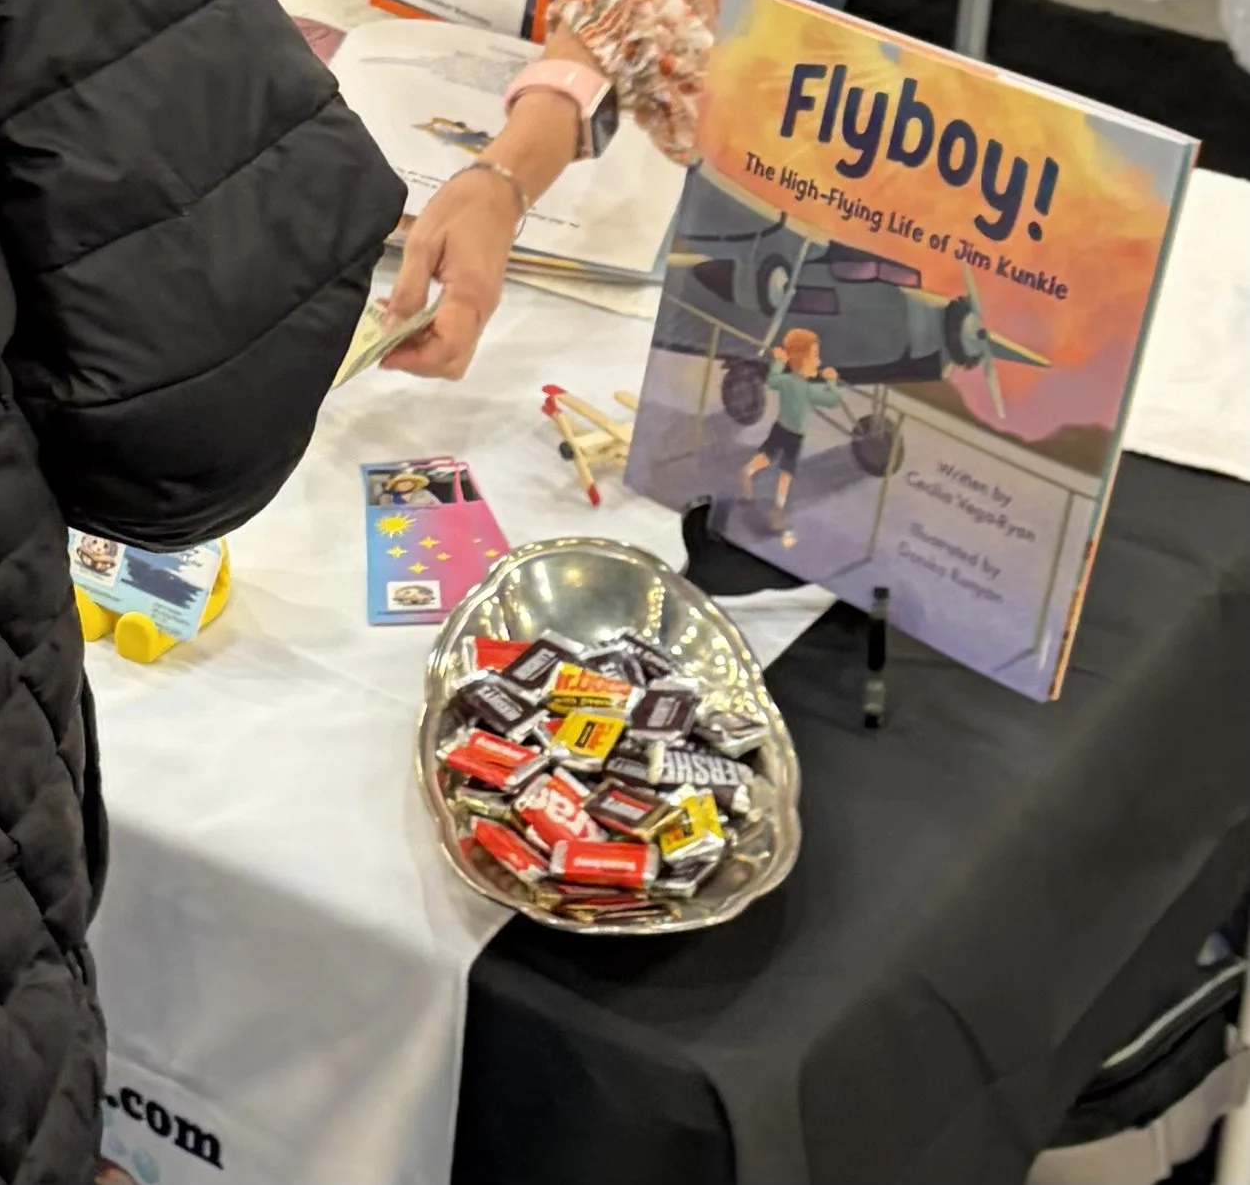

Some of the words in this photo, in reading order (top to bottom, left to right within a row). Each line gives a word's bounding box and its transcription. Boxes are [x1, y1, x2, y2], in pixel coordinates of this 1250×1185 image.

[746, 152, 775, 181] The
[780, 168, 884, 233] High-Flying
[887, 211, 924, 243] Life
[929, 232, 952, 254] of
[953, 239, 992, 271] Jim
[995, 255, 1069, 301] Kunkle
[780, 63, 1060, 242] Flyboy!
